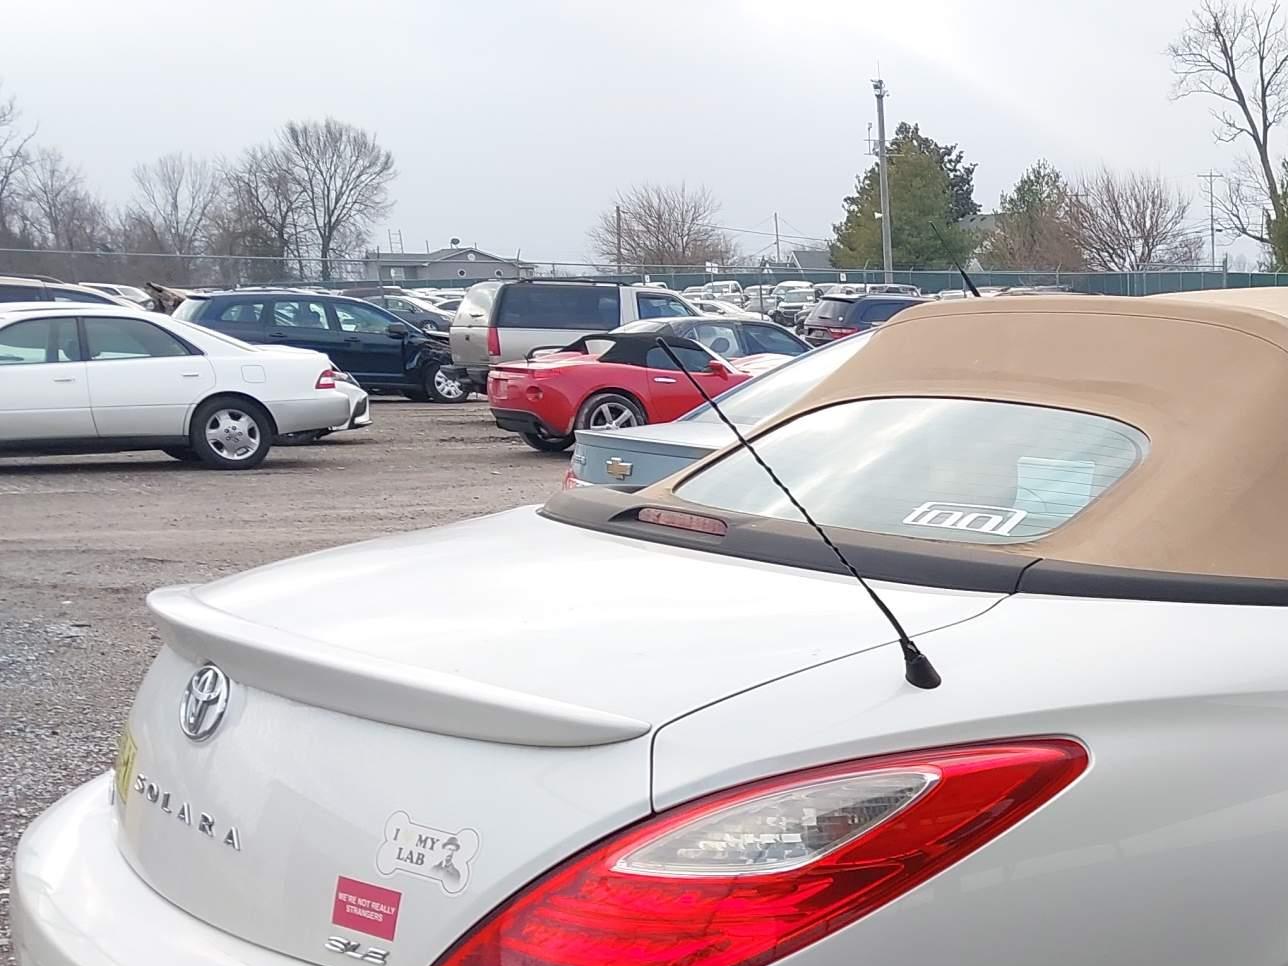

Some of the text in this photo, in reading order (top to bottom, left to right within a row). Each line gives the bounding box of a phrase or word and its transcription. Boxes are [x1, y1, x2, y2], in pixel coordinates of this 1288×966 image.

[134, 773, 241, 851] SOLARA
[393, 828, 440, 851] I MY
[396, 847, 425, 866] LAB
[338, 892, 396, 915] WE'RE NOT REALLY
[346, 905, 383, 921] STRANGERS
[324, 935, 390, 966] SLE
